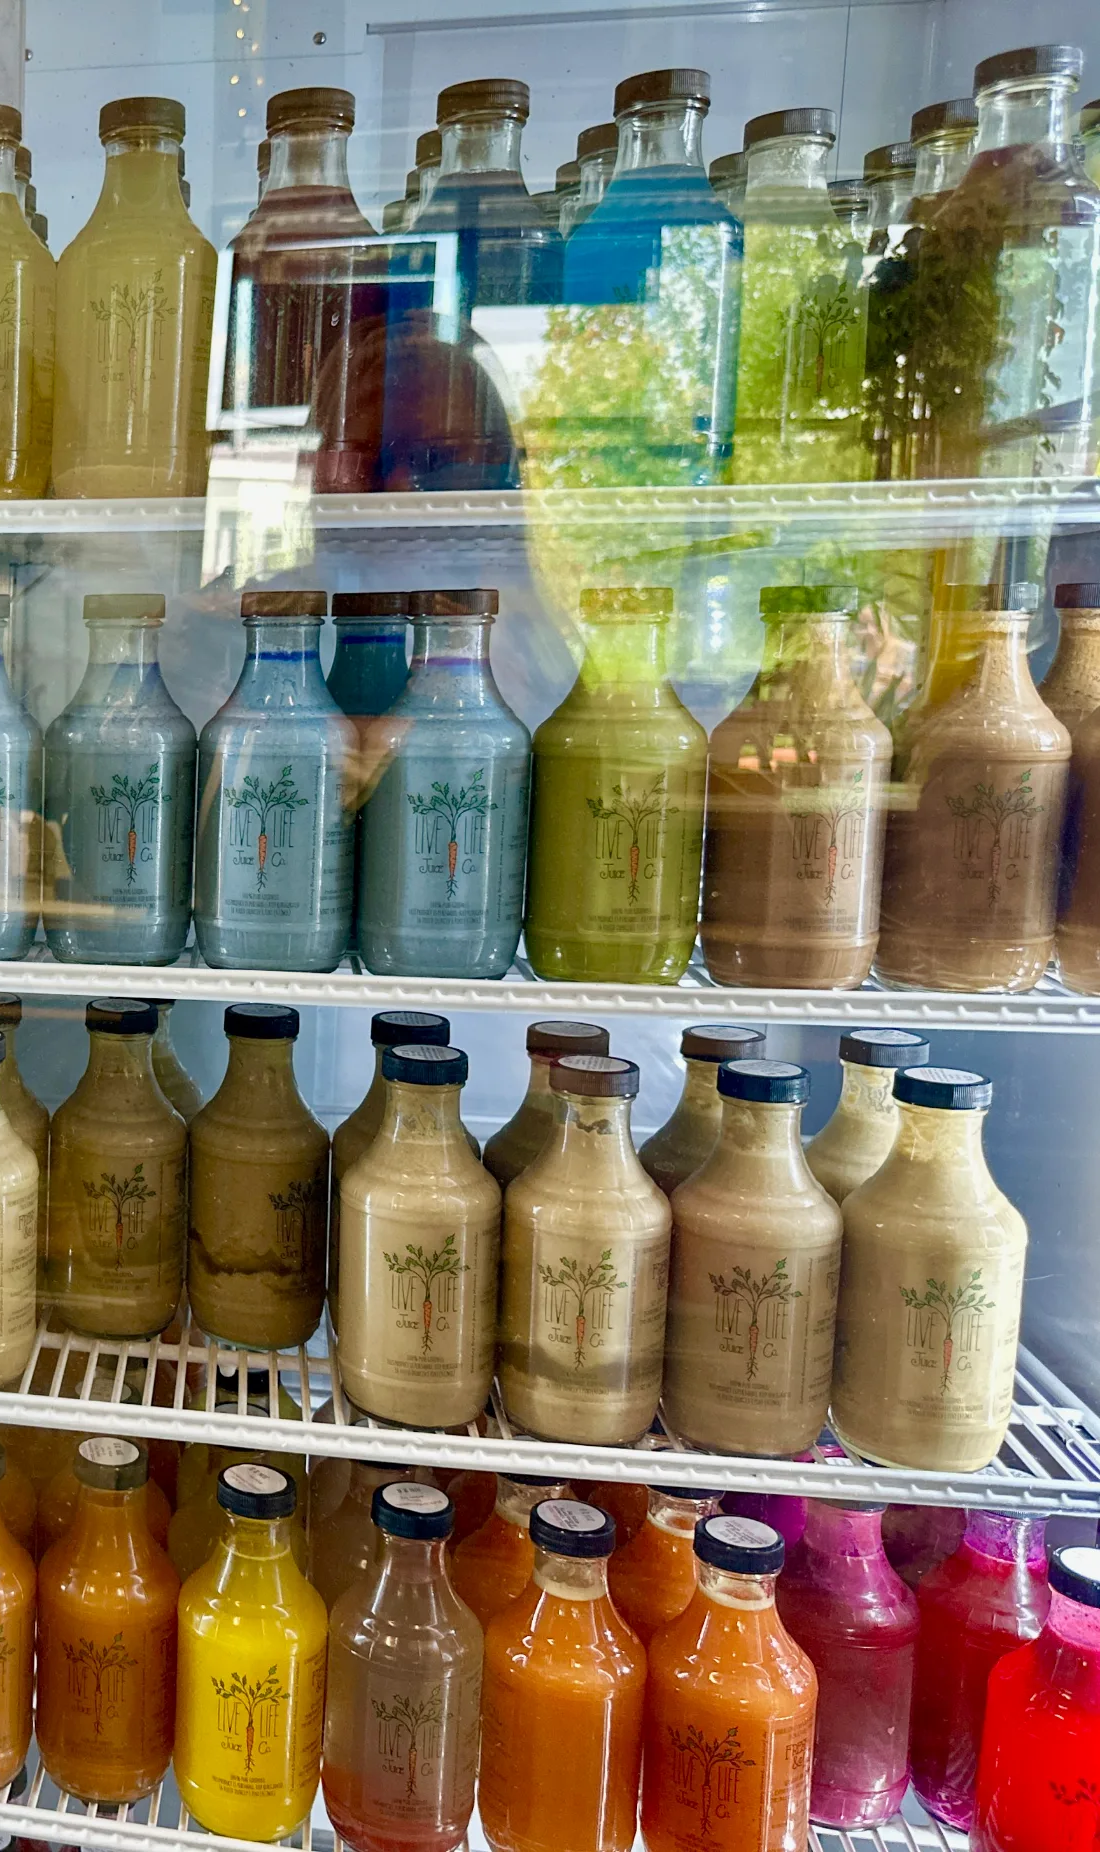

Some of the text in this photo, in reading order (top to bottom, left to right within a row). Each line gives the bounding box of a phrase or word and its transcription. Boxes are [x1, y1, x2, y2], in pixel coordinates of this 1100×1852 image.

[97, 806, 122, 843] LIVE
[229, 809, 254, 848] LIVE
[273, 809, 297, 848] LIFE
[414, 815, 486, 855] LIVE LIFE
[594, 819, 668, 860] LIVE LIFE
[791, 818, 865, 860] LIVE LIFE
[952, 817, 1030, 860] LIVE LIFE
[102, 846, 124, 863] Juice
[233, 850, 255, 866] Juice
[418, 857, 444, 875] Juice
[599, 863, 626, 880] Juice
[796, 863, 823, 880] Juice
[958, 863, 985, 880] Juice
[89, 1200, 145, 1234] LIVE LIFE
[276, 1211, 298, 1244] LIVE
[391, 1274, 459, 1313] LIVE LIFE
[544, 1286, 616, 1331] LIVE LIFE
[395, 1313, 420, 1330] Juice
[714, 1295, 790, 1340] LIVE LIFE
[906, 1310, 985, 1352] LIVE LIFE
[547, 1327, 572, 1345] Juice
[718, 1336, 745, 1354] Juice
[910, 1351, 938, 1369] Juice
[68, 1663, 124, 1703] LIVE LIFE
[217, 1697, 281, 1739] LIVE LIFE
[221, 1736, 243, 1753] Juice
[377, 1721, 442, 1760] LIVE LIFE
[382, 1758, 404, 1775] Juice
[672, 1750, 743, 1804] LIVE LIFE
